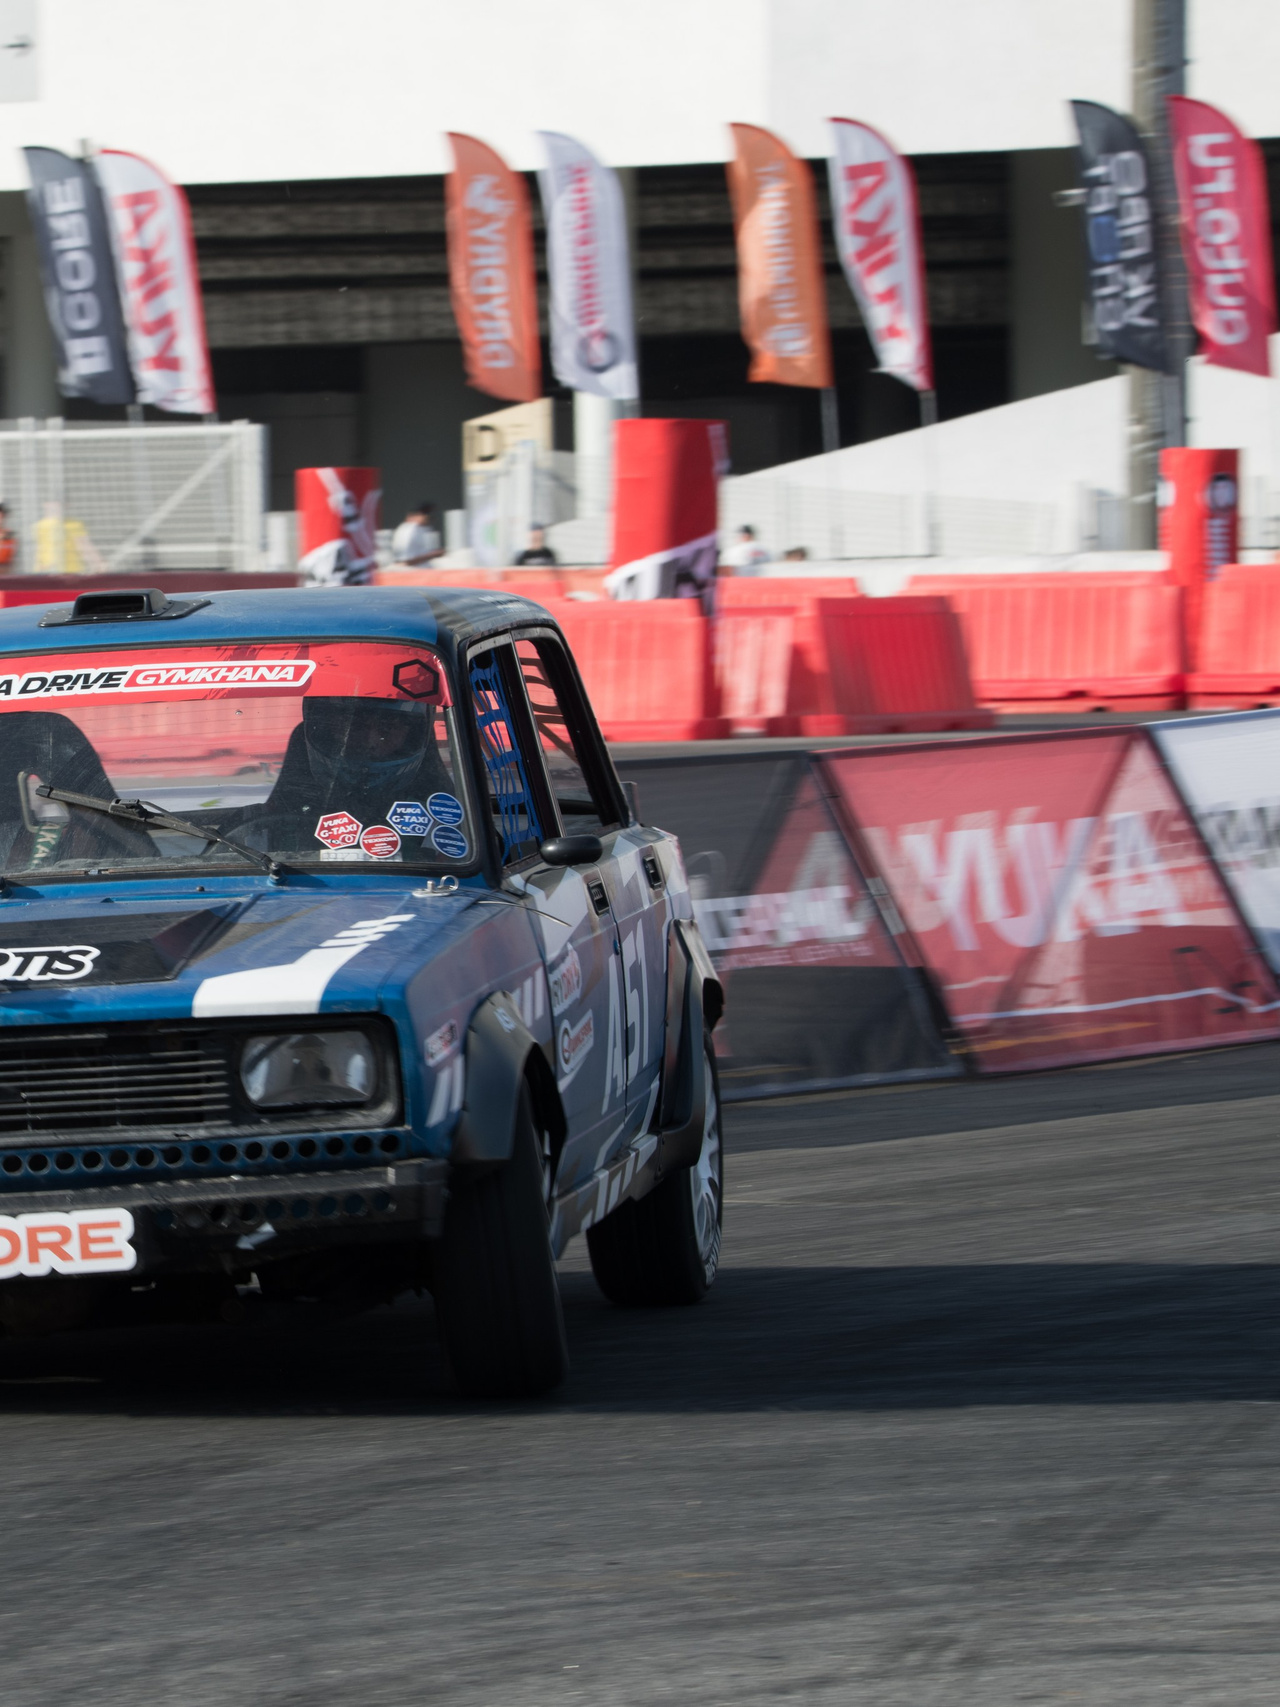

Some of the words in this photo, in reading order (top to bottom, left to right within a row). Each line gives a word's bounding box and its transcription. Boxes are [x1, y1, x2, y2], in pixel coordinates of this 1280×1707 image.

[17, 670, 128, 696] DRIVE
[135, 665, 296, 685] GYMKHANA
[395, 807, 422, 815] YUKA
[323, 816, 349, 828] YUKA
[391, 815, 429, 824] G-TAXI
[319, 823, 358, 838] G-TAXI
[600, 917, 650, 1116] A51
